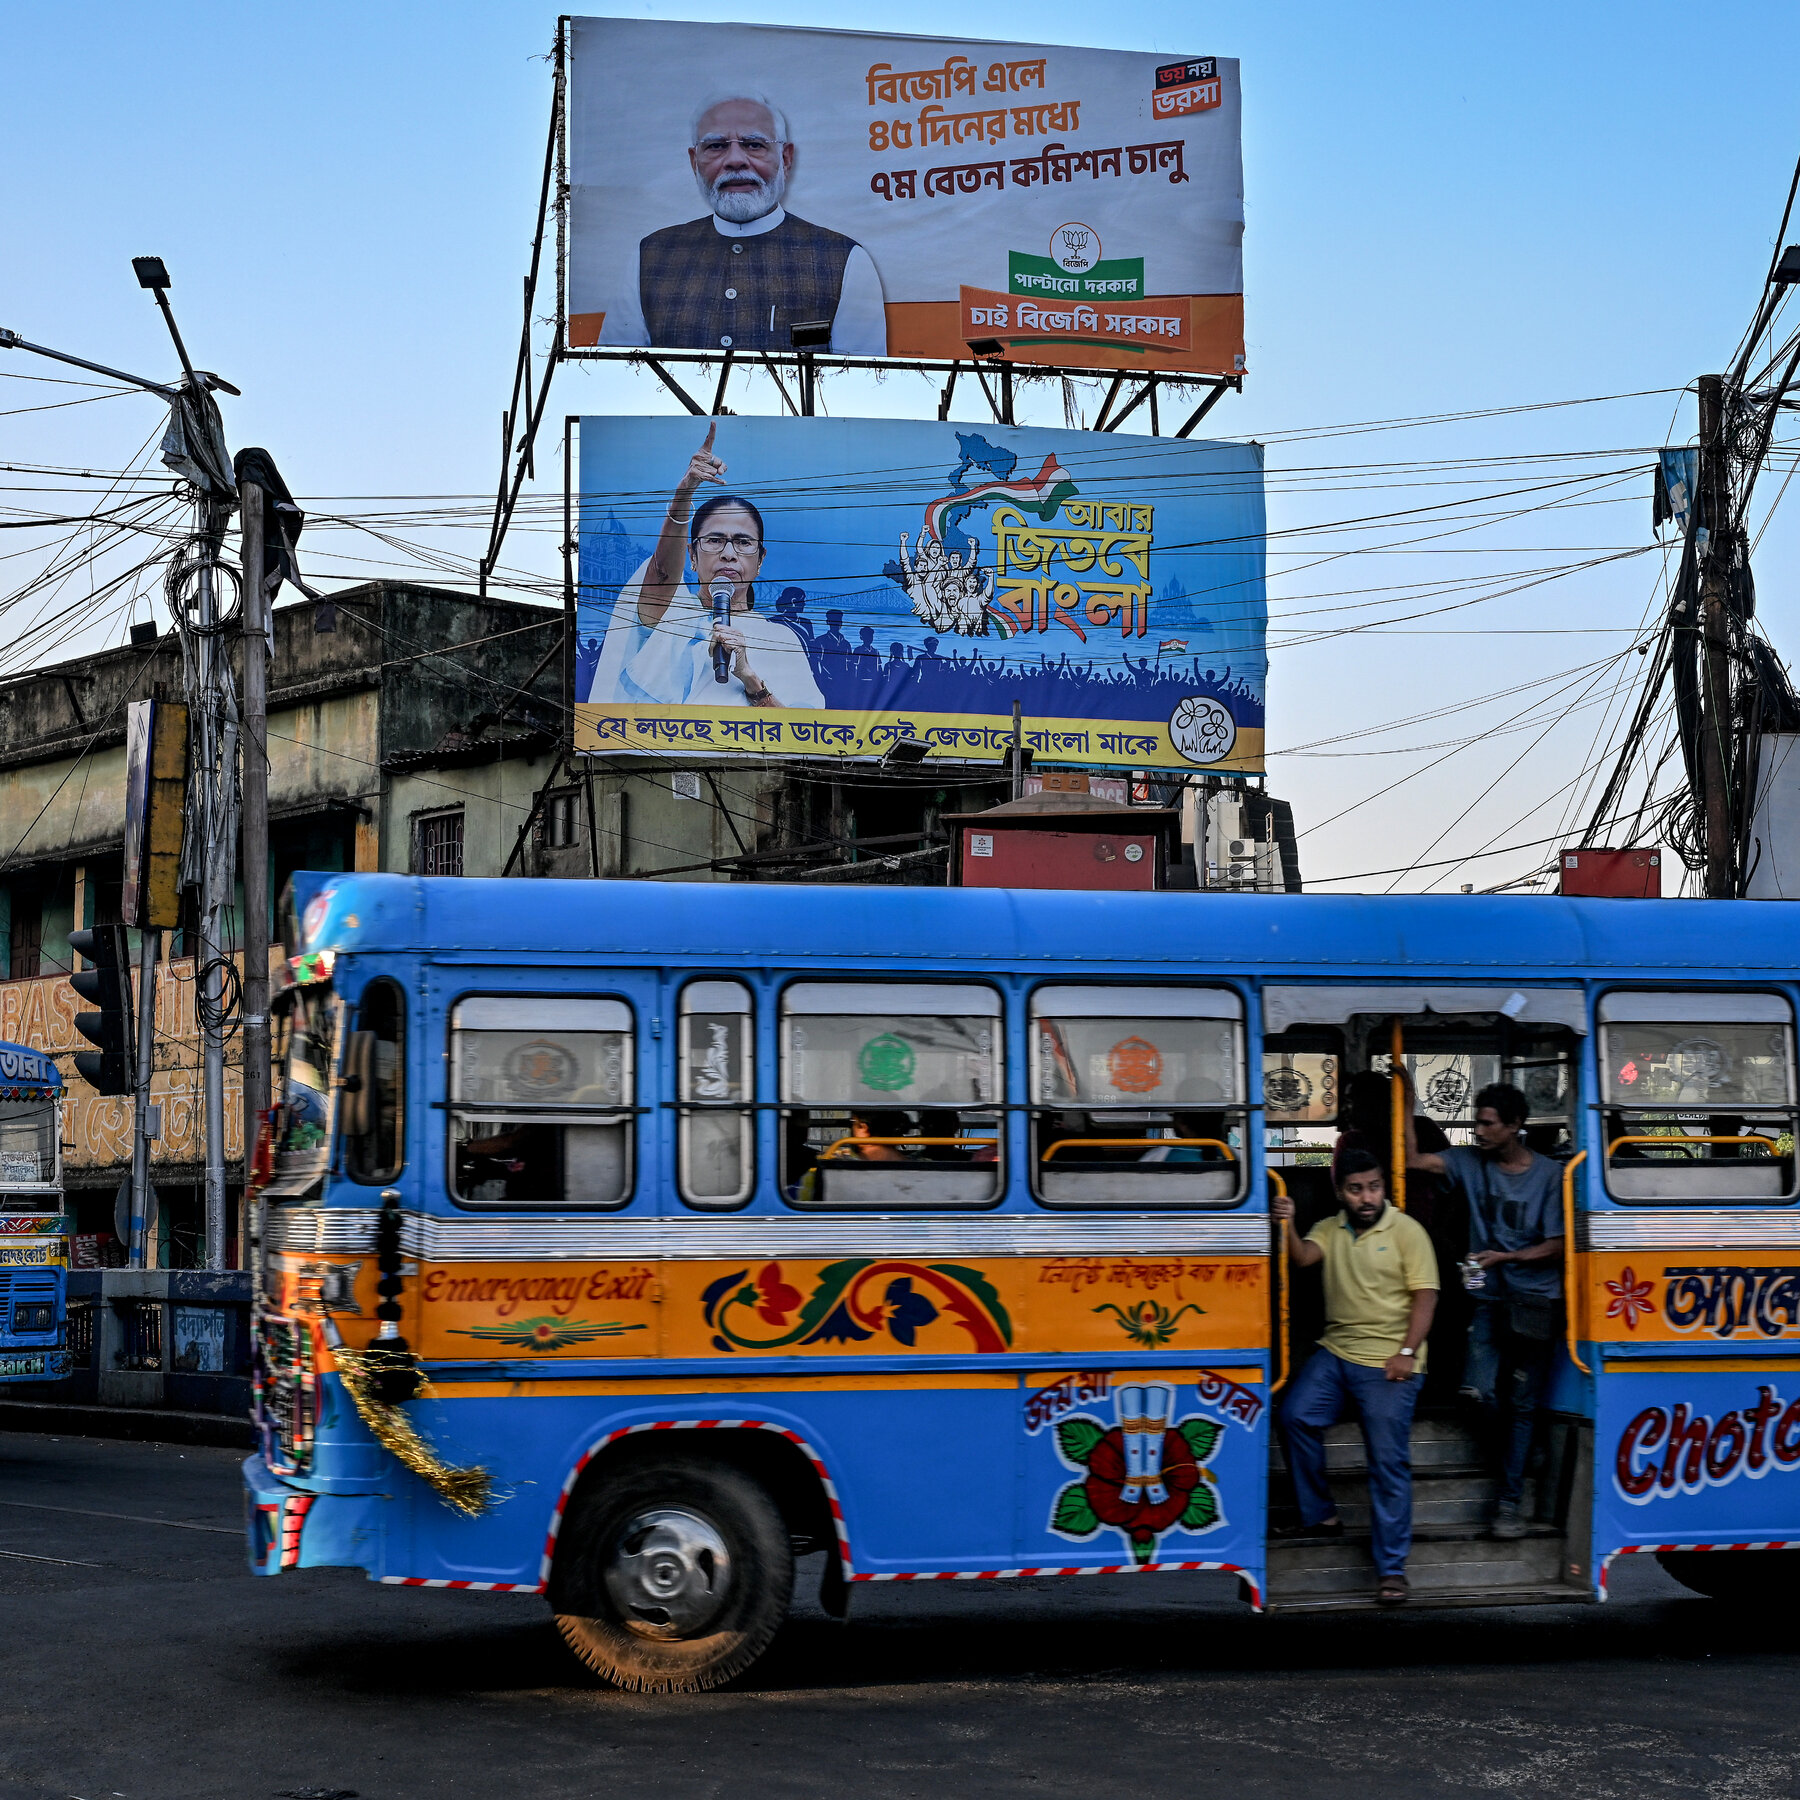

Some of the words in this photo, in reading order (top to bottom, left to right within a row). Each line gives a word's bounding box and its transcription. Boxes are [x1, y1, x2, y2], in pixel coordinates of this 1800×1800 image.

[866, 56, 977, 105] বিজেপি
[983, 58, 1046, 97] এলে
[1158, 66, 1186, 83] ভয়
[1187, 60, 1213, 78] নয়
[1154, 81, 1219, 113] ভরসা
[868, 119, 913, 152] ৪৫
[918, 105, 1007, 146] দিনের
[1011, 101, 1081, 136] মধ্যে
[870, 169, 916, 200] ৭ম
[923, 160, 1005, 196] বেতন
[1010, 143, 1122, 188] কমিশন
[1126, 140, 1190, 184] চালু
[1062, 257, 1089, 268] বিজেপি
[1014, 272, 1080, 294] পাল্টানো
[1084, 278, 1138, 296] দরকার
[970, 302, 1008, 329] চাই
[1016, 303, 1099, 332] বিজেপি
[1105, 313, 1181, 338] সরকার
[1060, 500, 1155, 534] আবার
[991, 507, 1154, 580] জিতবে
[995, 575, 1153, 644] বাংলা
[596, 716, 629, 740] যে
[633, 717, 716, 744] লড়ছে
[720, 718, 782, 744] সবার
[789, 720, 863, 750] ডাকে,
[868, 717, 916, 746] সেই
[1025, 727, 1090, 754] বাংলা
[1097, 731, 1159, 757] মাকে
[587, 1267, 654, 1300] Exit
